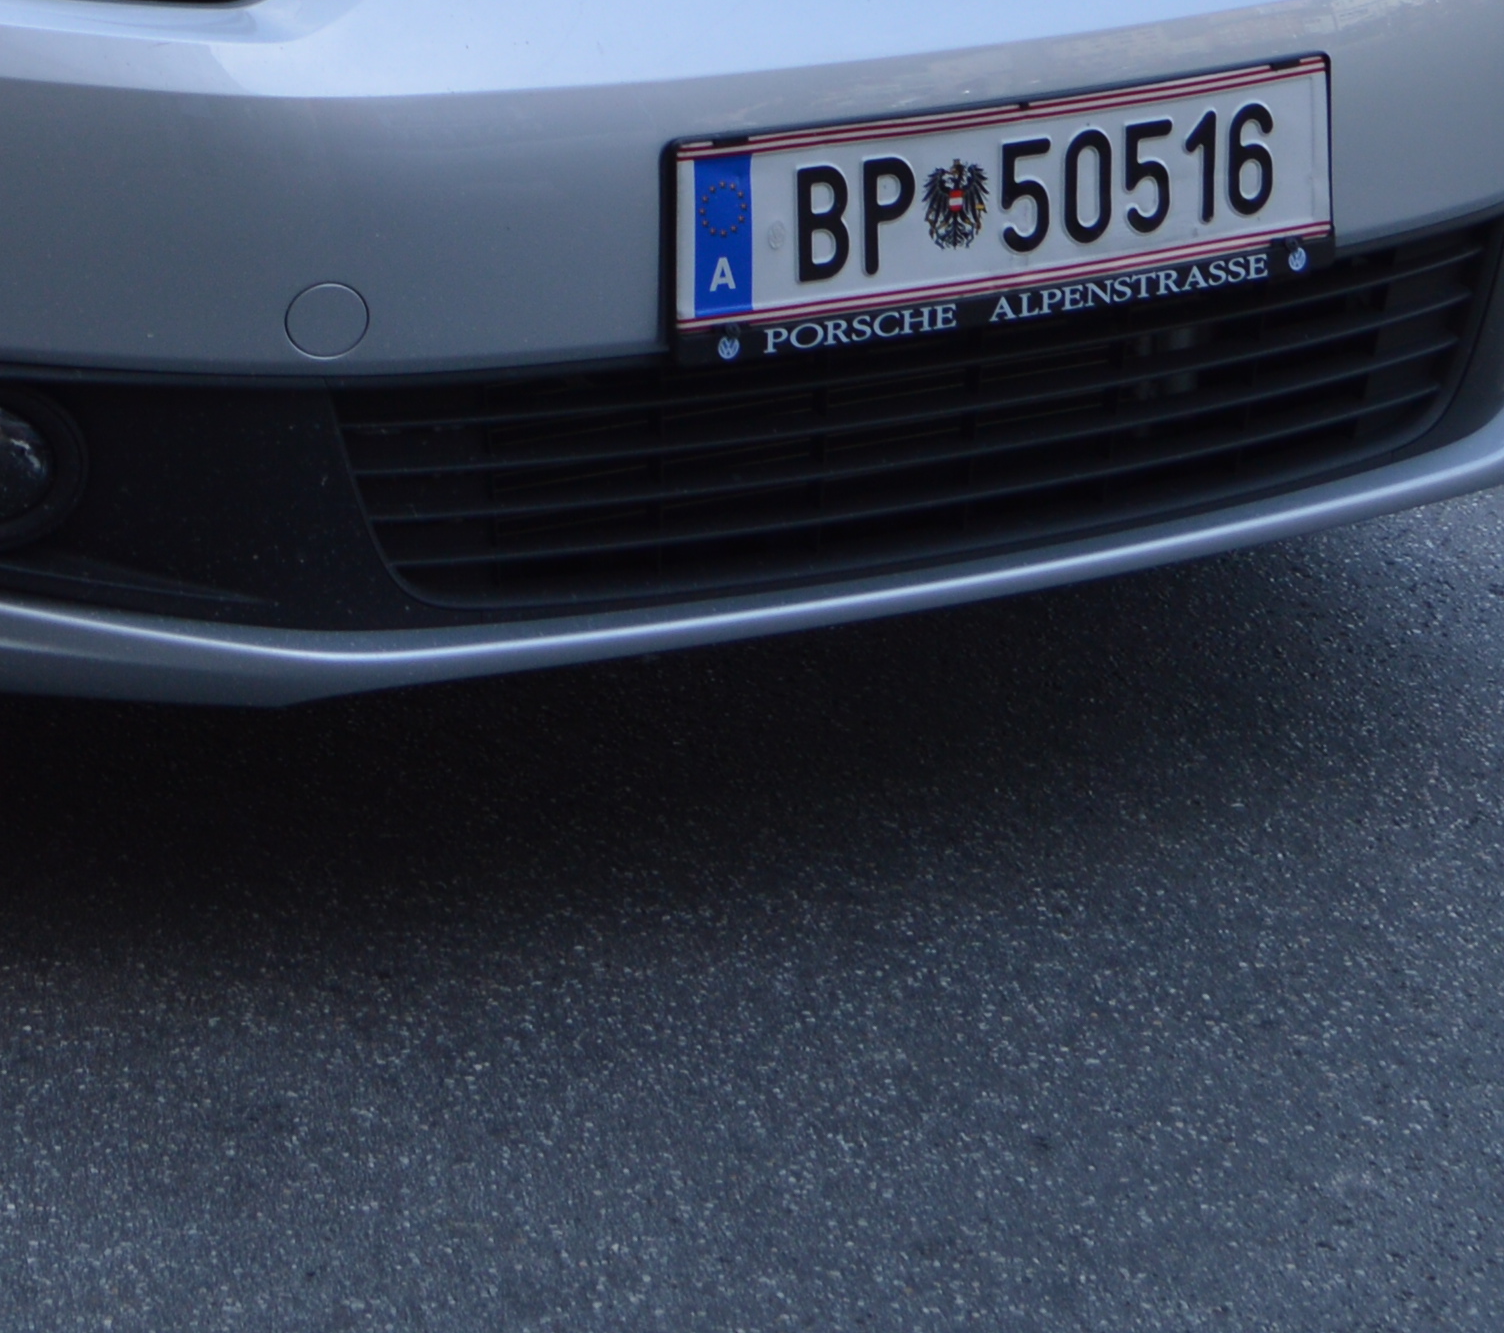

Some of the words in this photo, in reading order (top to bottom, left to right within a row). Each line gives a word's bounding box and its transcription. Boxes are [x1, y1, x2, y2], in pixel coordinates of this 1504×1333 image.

[796, 156, 916, 283] BP
[999, 101, 1275, 254] 50516
[708, 256, 737, 293] A
[763, 302, 958, 355] PORSCHE
[989, 253, 1269, 323] ALPENSTRASSE
